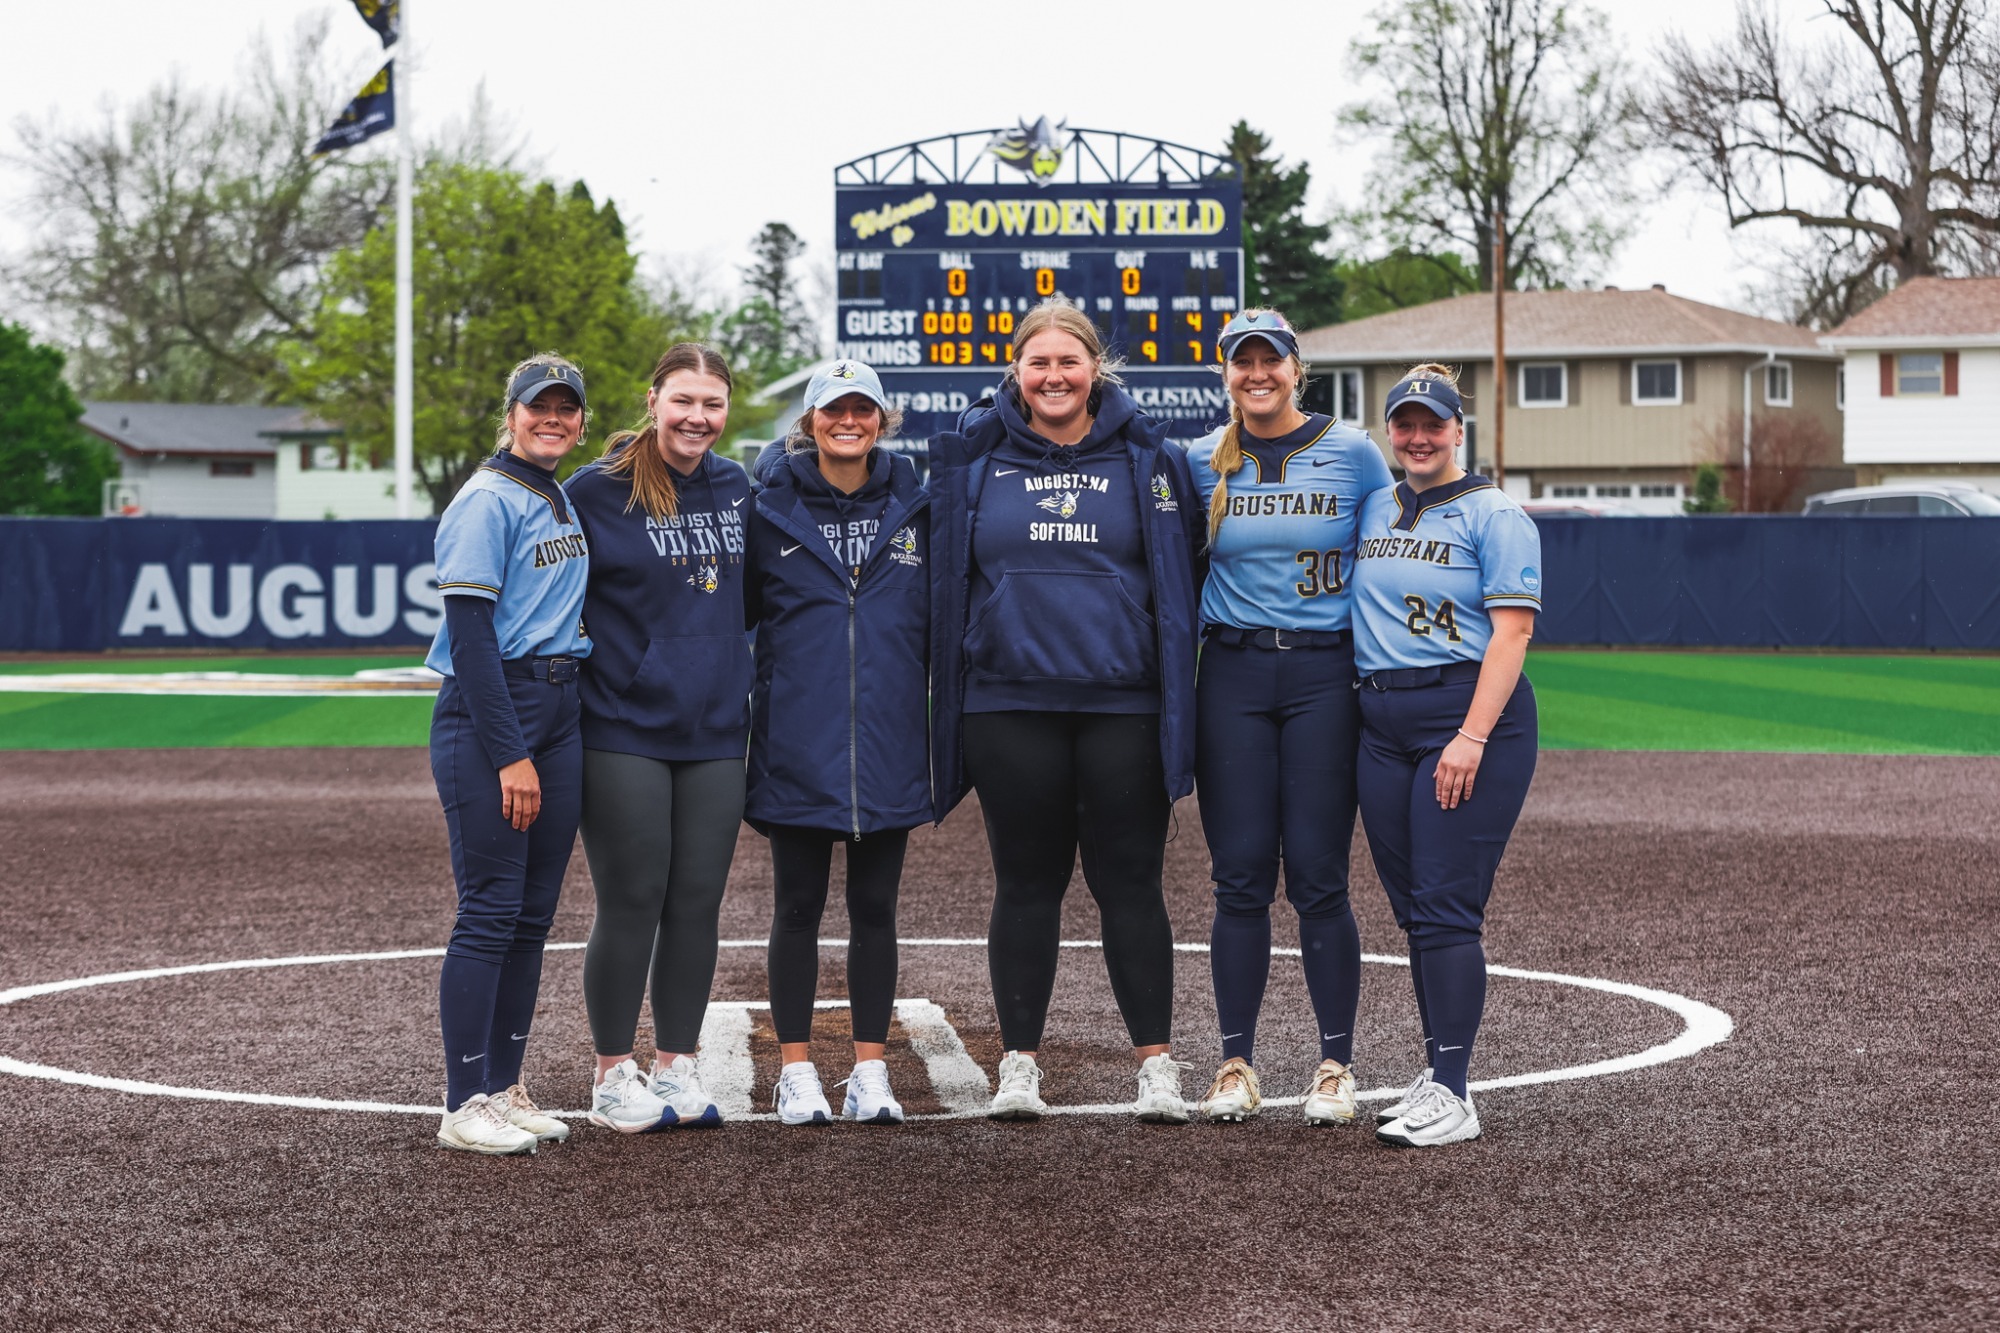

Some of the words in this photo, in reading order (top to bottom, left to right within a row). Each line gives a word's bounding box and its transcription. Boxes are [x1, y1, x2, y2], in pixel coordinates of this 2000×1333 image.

[945, 200, 1108, 236] BOWDEN
[1114, 199, 1225, 235] FIELD
[838, 254, 855, 269] AT
[857, 253, 883, 269] BAT
[939, 252, 973, 269] BALL
[1020, 251, 1070, 269] STRIKE
[1115, 251, 1146, 269] OUT
[948, 269, 966, 295] 0
[1036, 268, 1054, 295] 0
[1122, 268, 1140, 295] 0
[846, 310, 917, 335] GUEST
[836, 340, 921, 365] VIKINGS
[1142, 340, 1157, 362] 9
[1188, 340, 1202, 362] 7
[1122, 386, 1228, 409] UGUSTAN
[1405, 381, 1431, 395] AU
[1225, 493, 1338, 516] UGUSTANA
[647, 525, 745, 556] VIKINGS
[1029, 522, 1098, 542] SOFTBALL
[672, 555, 740, 566] SOTBLL
[1296, 548, 1343, 597] 30
[1404, 594, 1461, 642] 24
